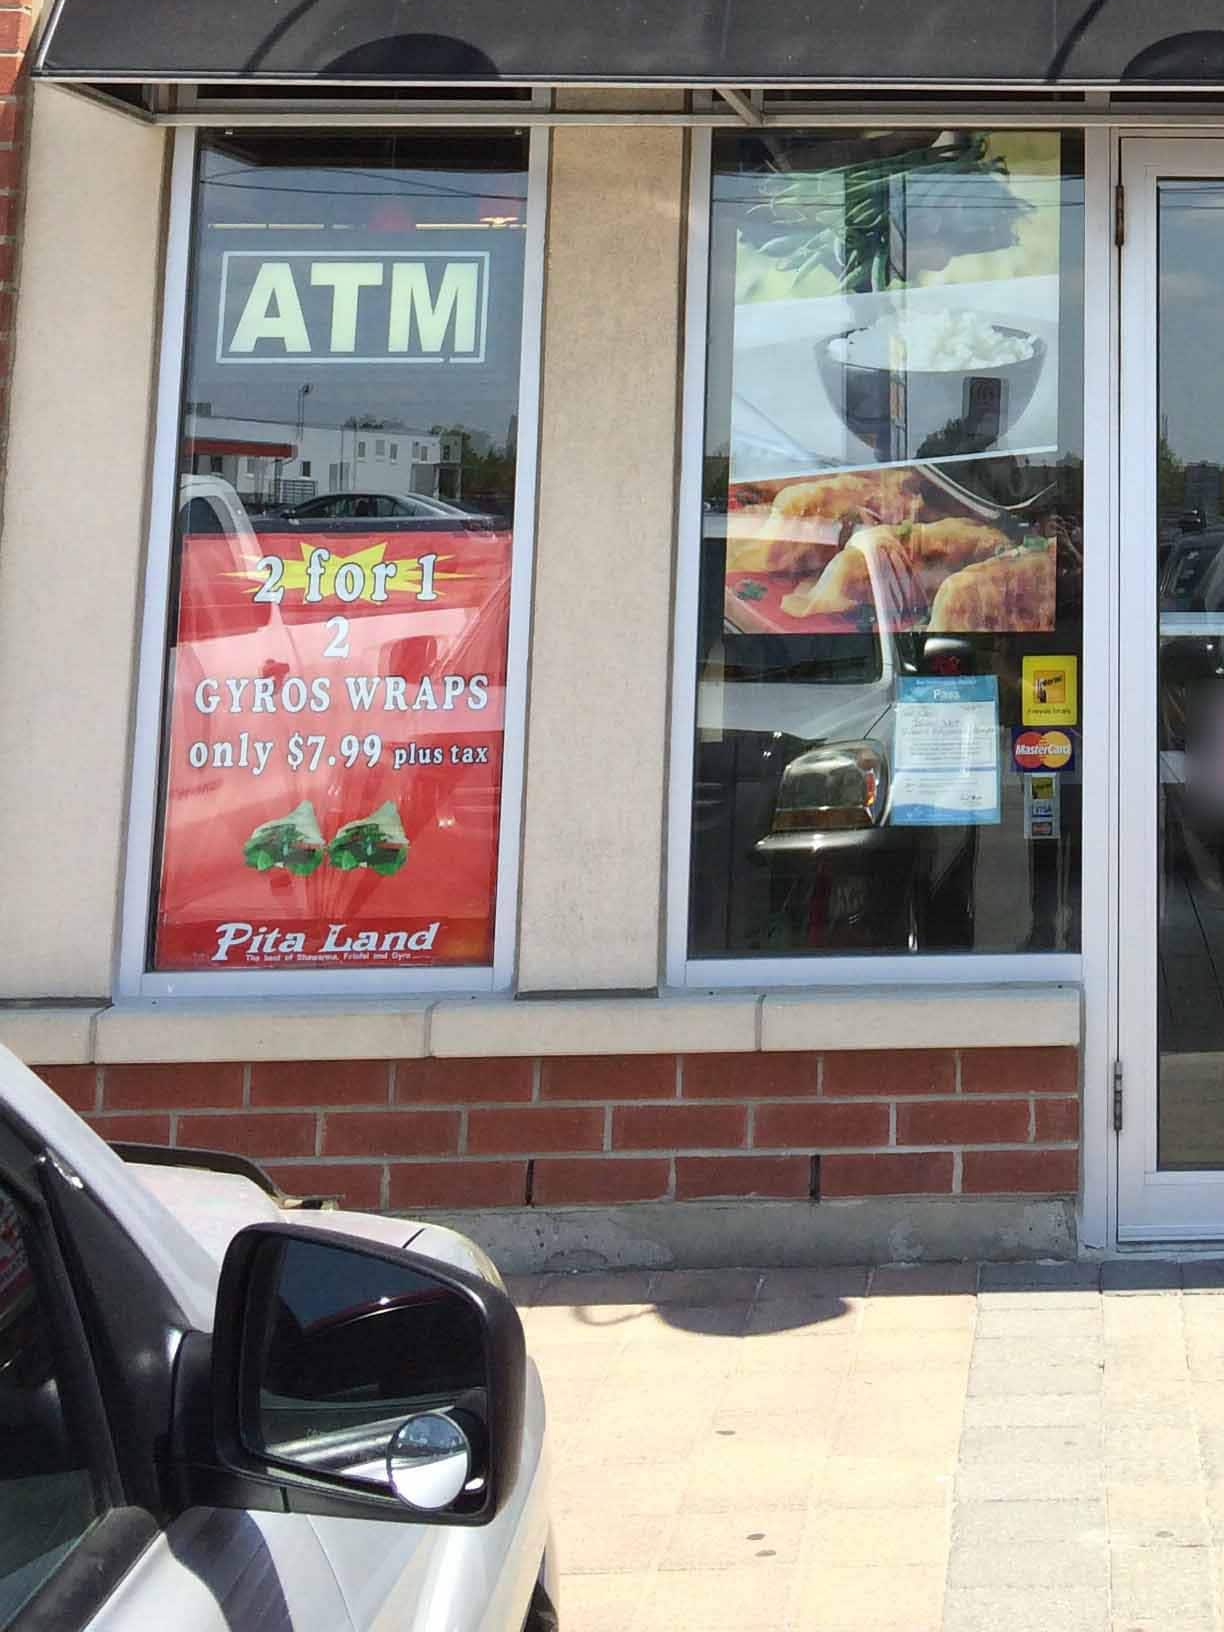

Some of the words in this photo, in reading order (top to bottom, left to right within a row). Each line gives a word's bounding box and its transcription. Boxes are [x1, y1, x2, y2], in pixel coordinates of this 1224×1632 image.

[228, 262, 478, 354] ATM
[253, 554, 286, 604] 2
[305, 548, 398, 603] for
[416, 554, 438, 602] 1
[323, 615, 351, 659] 2
[194, 676, 331, 714] GYROS
[345, 674, 490, 712] WRAPS
[188, 732, 273, 776] only
[287, 732, 383, 772] $7.99
[393, 744, 444, 769] plus
[450, 744, 490, 764] tax
[1015, 743, 1072, 756] MasterCard
[211, 922, 306, 961] Pita
[317, 922, 441, 953] Land
